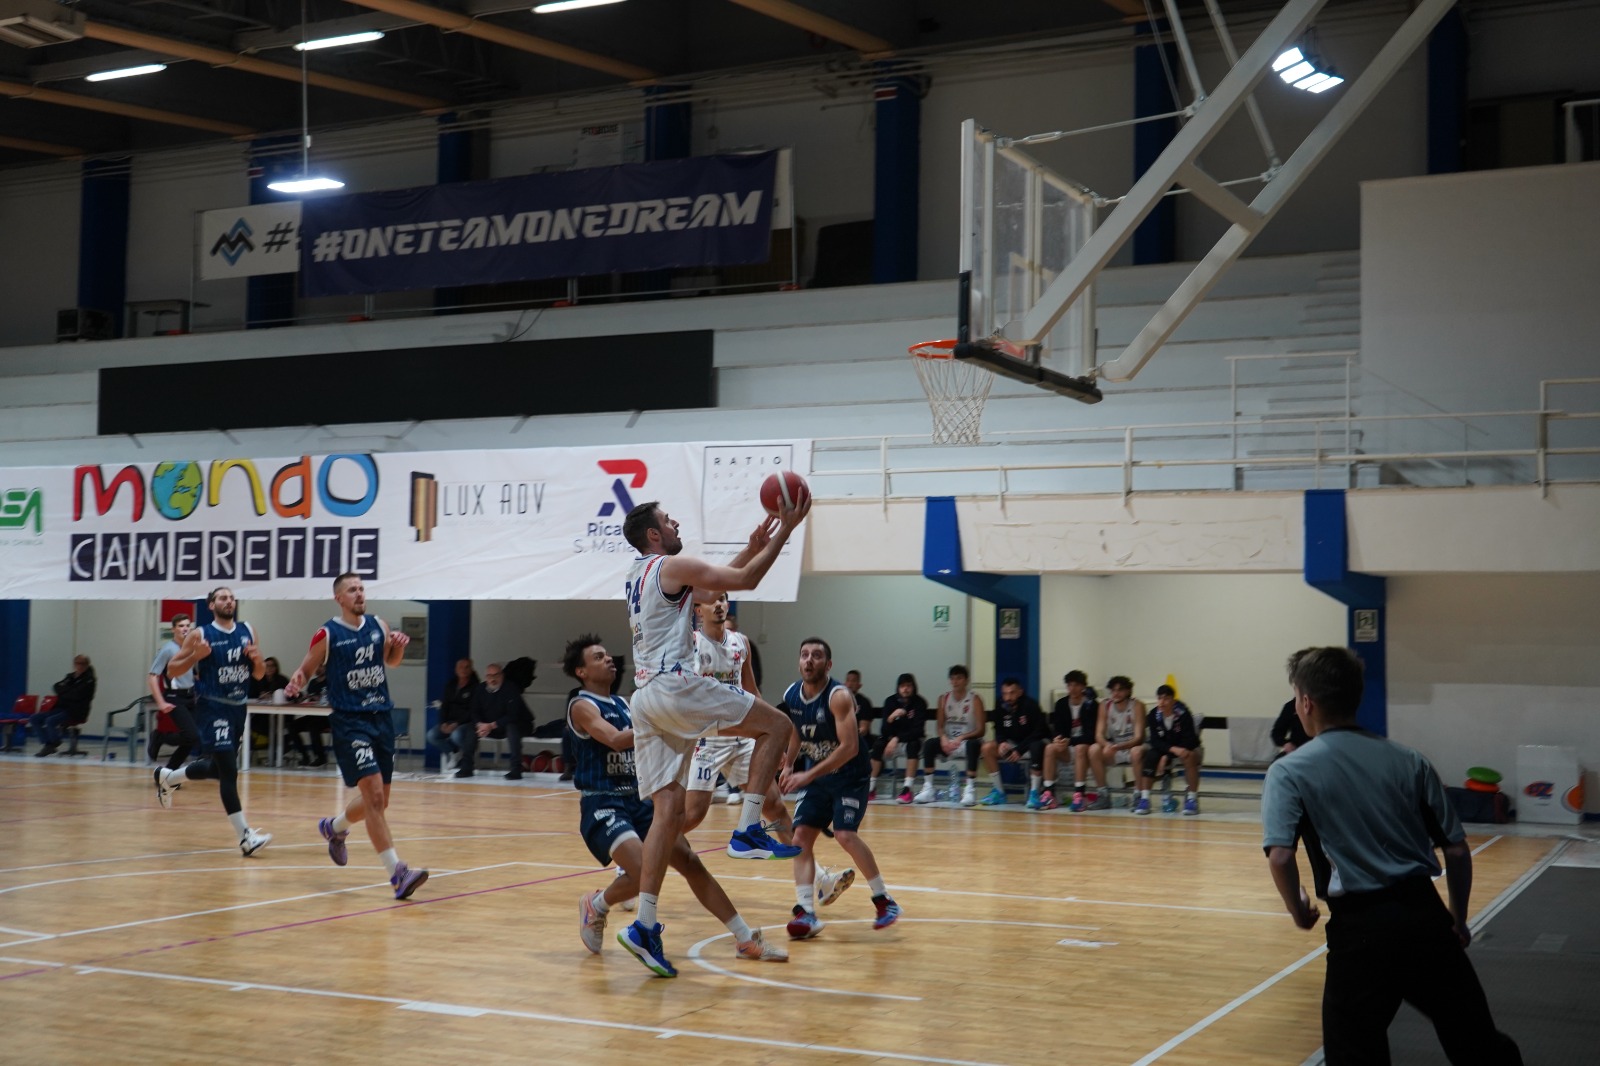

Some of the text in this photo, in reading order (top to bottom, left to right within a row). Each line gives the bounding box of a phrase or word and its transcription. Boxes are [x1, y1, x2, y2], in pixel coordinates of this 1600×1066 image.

[312, 190, 763, 262] #ONETEAMONEDREAM
[714, 456, 781, 465] RATIO
[443, 483, 546, 516] LUX ADV
[587, 521, 622, 536] Rica
[71, 531, 379, 581] CAMERETTE
[227, 646, 242, 663] 14
[355, 644, 374, 665] 24
[215, 726, 230, 741] 14
[801, 724, 817, 739] 17
[355, 746, 374, 766] 24
[698, 767, 711, 780] 10
